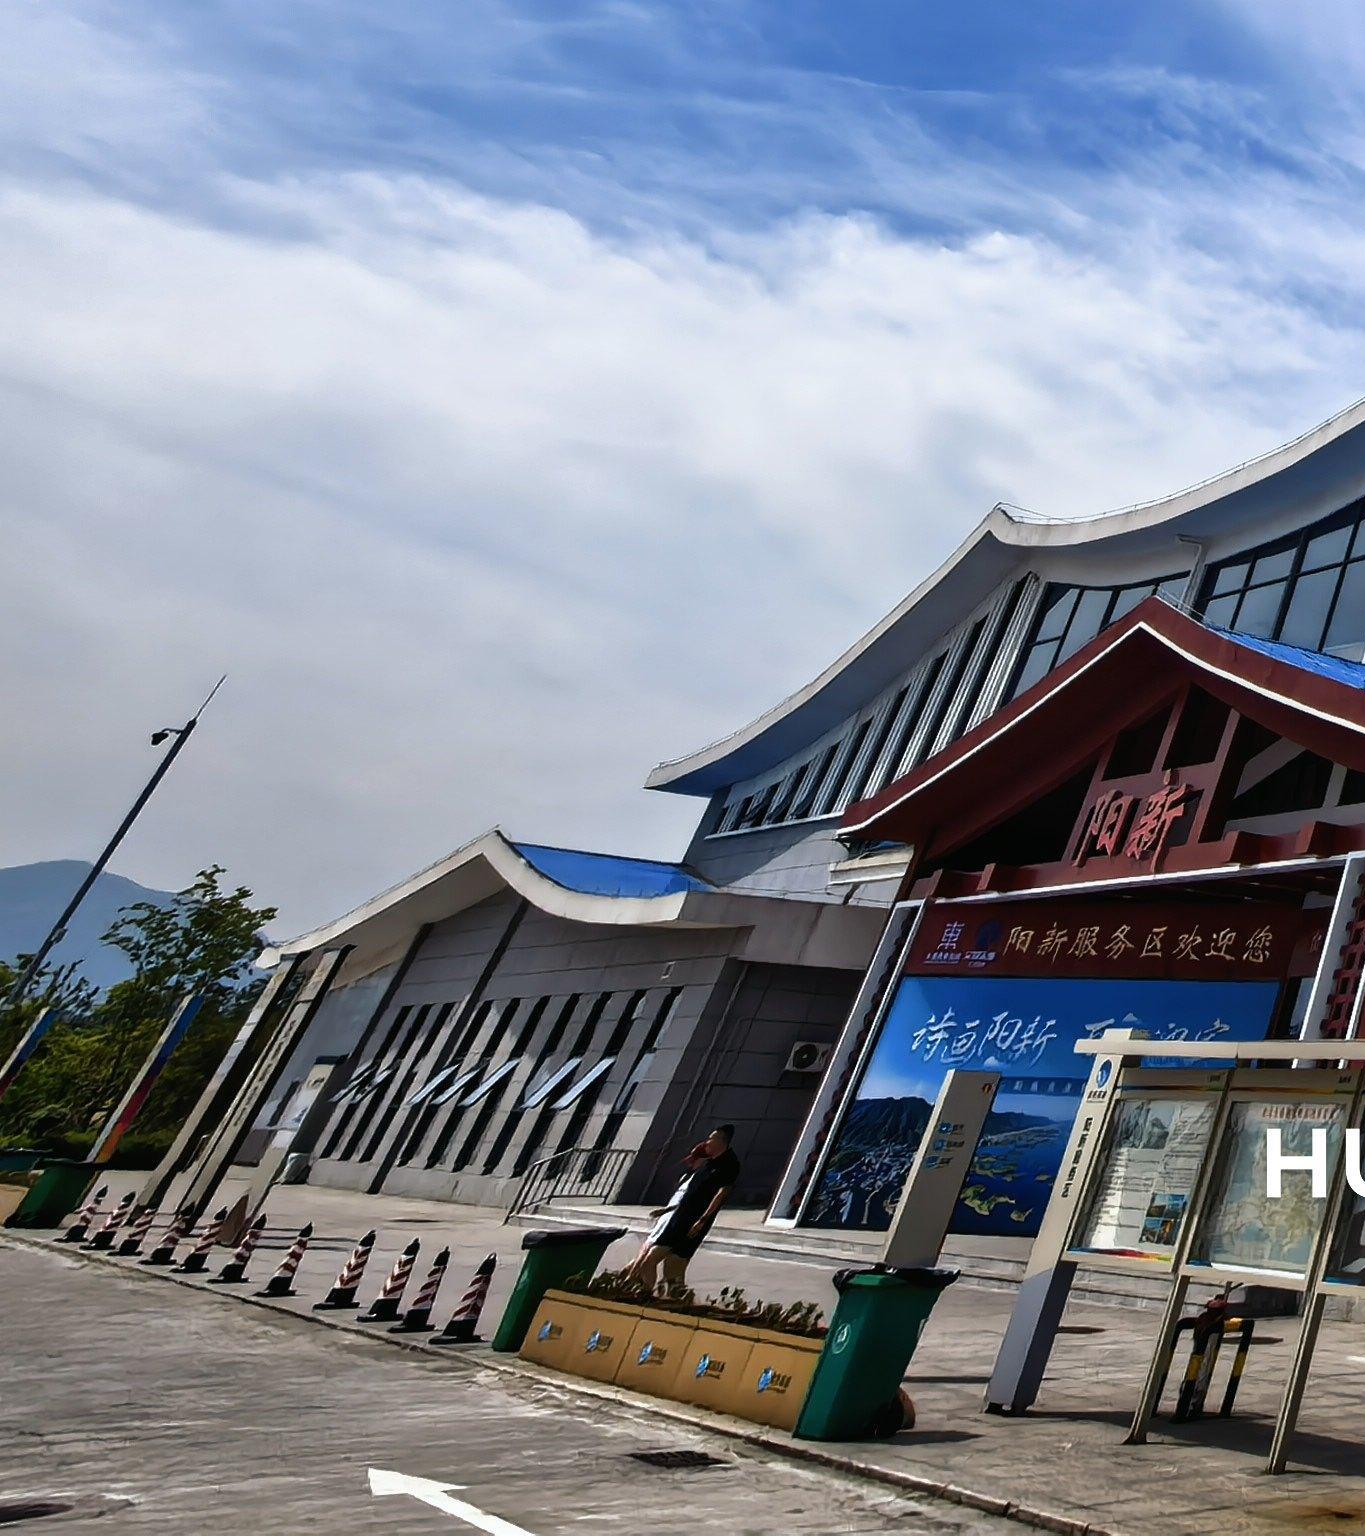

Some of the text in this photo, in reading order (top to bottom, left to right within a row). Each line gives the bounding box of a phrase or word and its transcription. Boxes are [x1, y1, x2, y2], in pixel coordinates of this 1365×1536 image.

[1072, 768, 1186, 874] 阳新
[1002, 921, 1273, 964] 阳新服务区欢迎您
